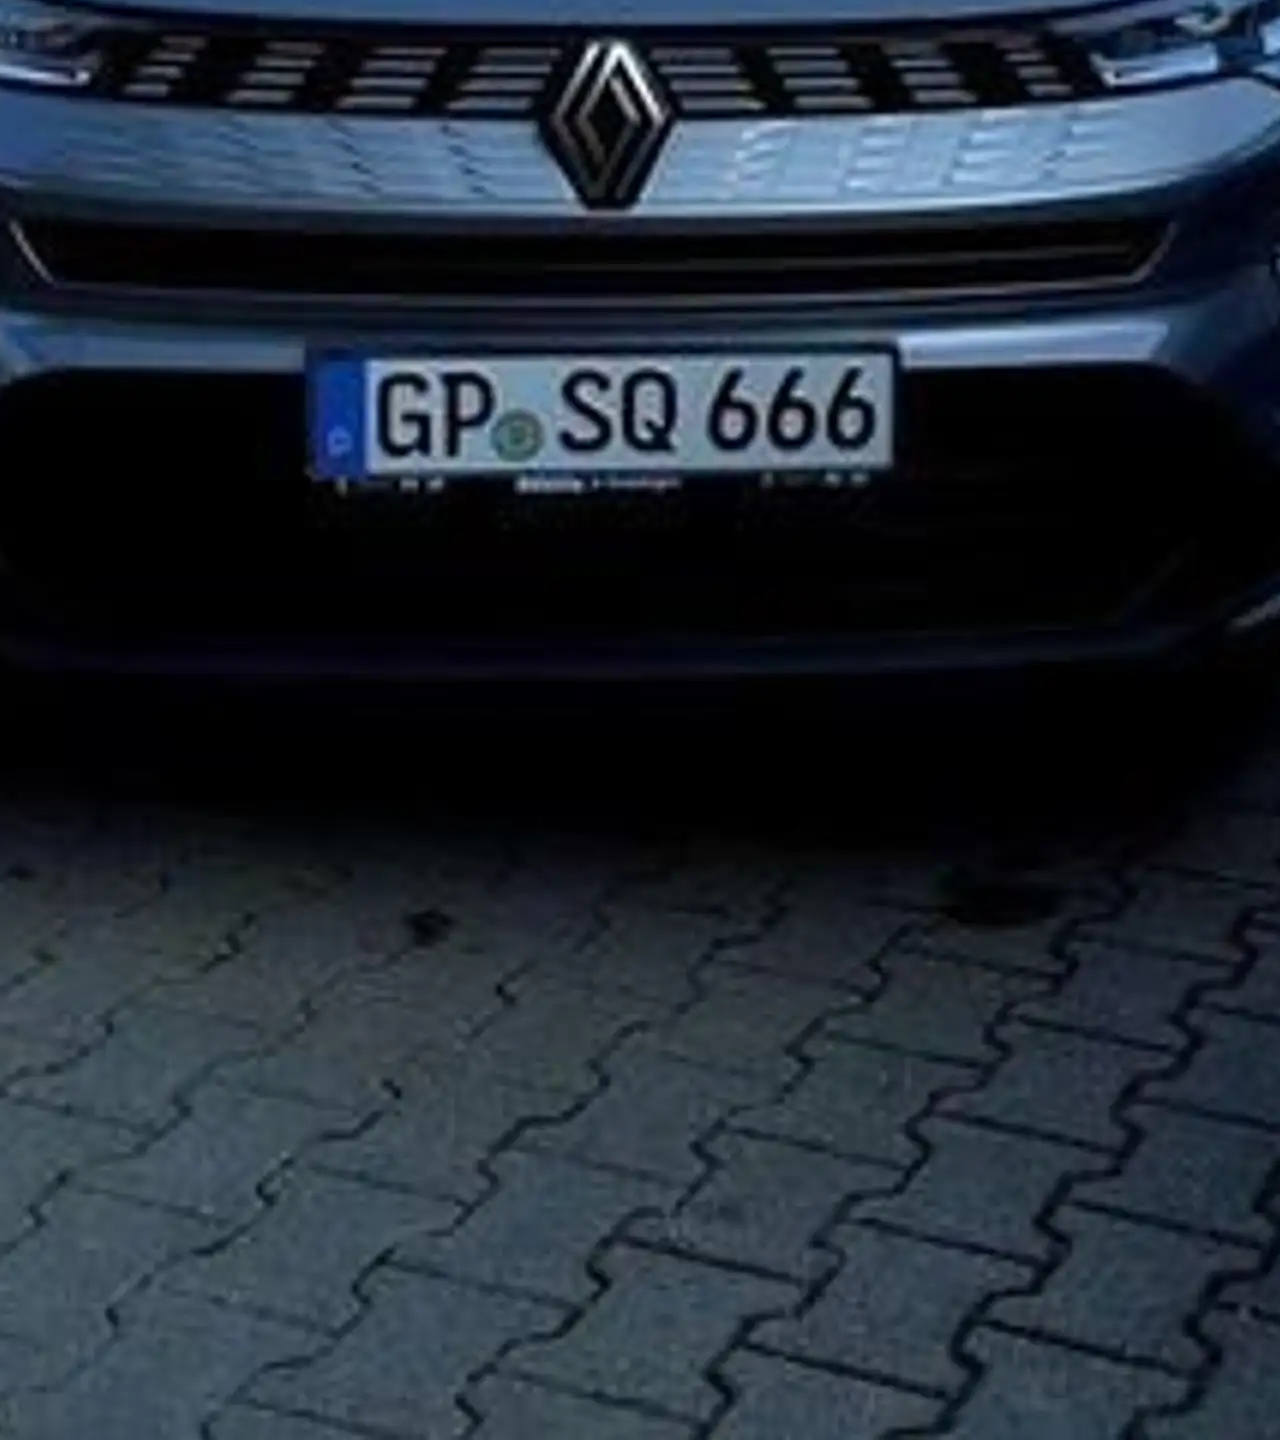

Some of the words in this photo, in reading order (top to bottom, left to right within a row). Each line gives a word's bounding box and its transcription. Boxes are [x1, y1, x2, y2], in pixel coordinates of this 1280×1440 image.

[376, 370, 494, 458] GP
[560, 368, 677, 454] SQ
[706, 367, 876, 451] 666
